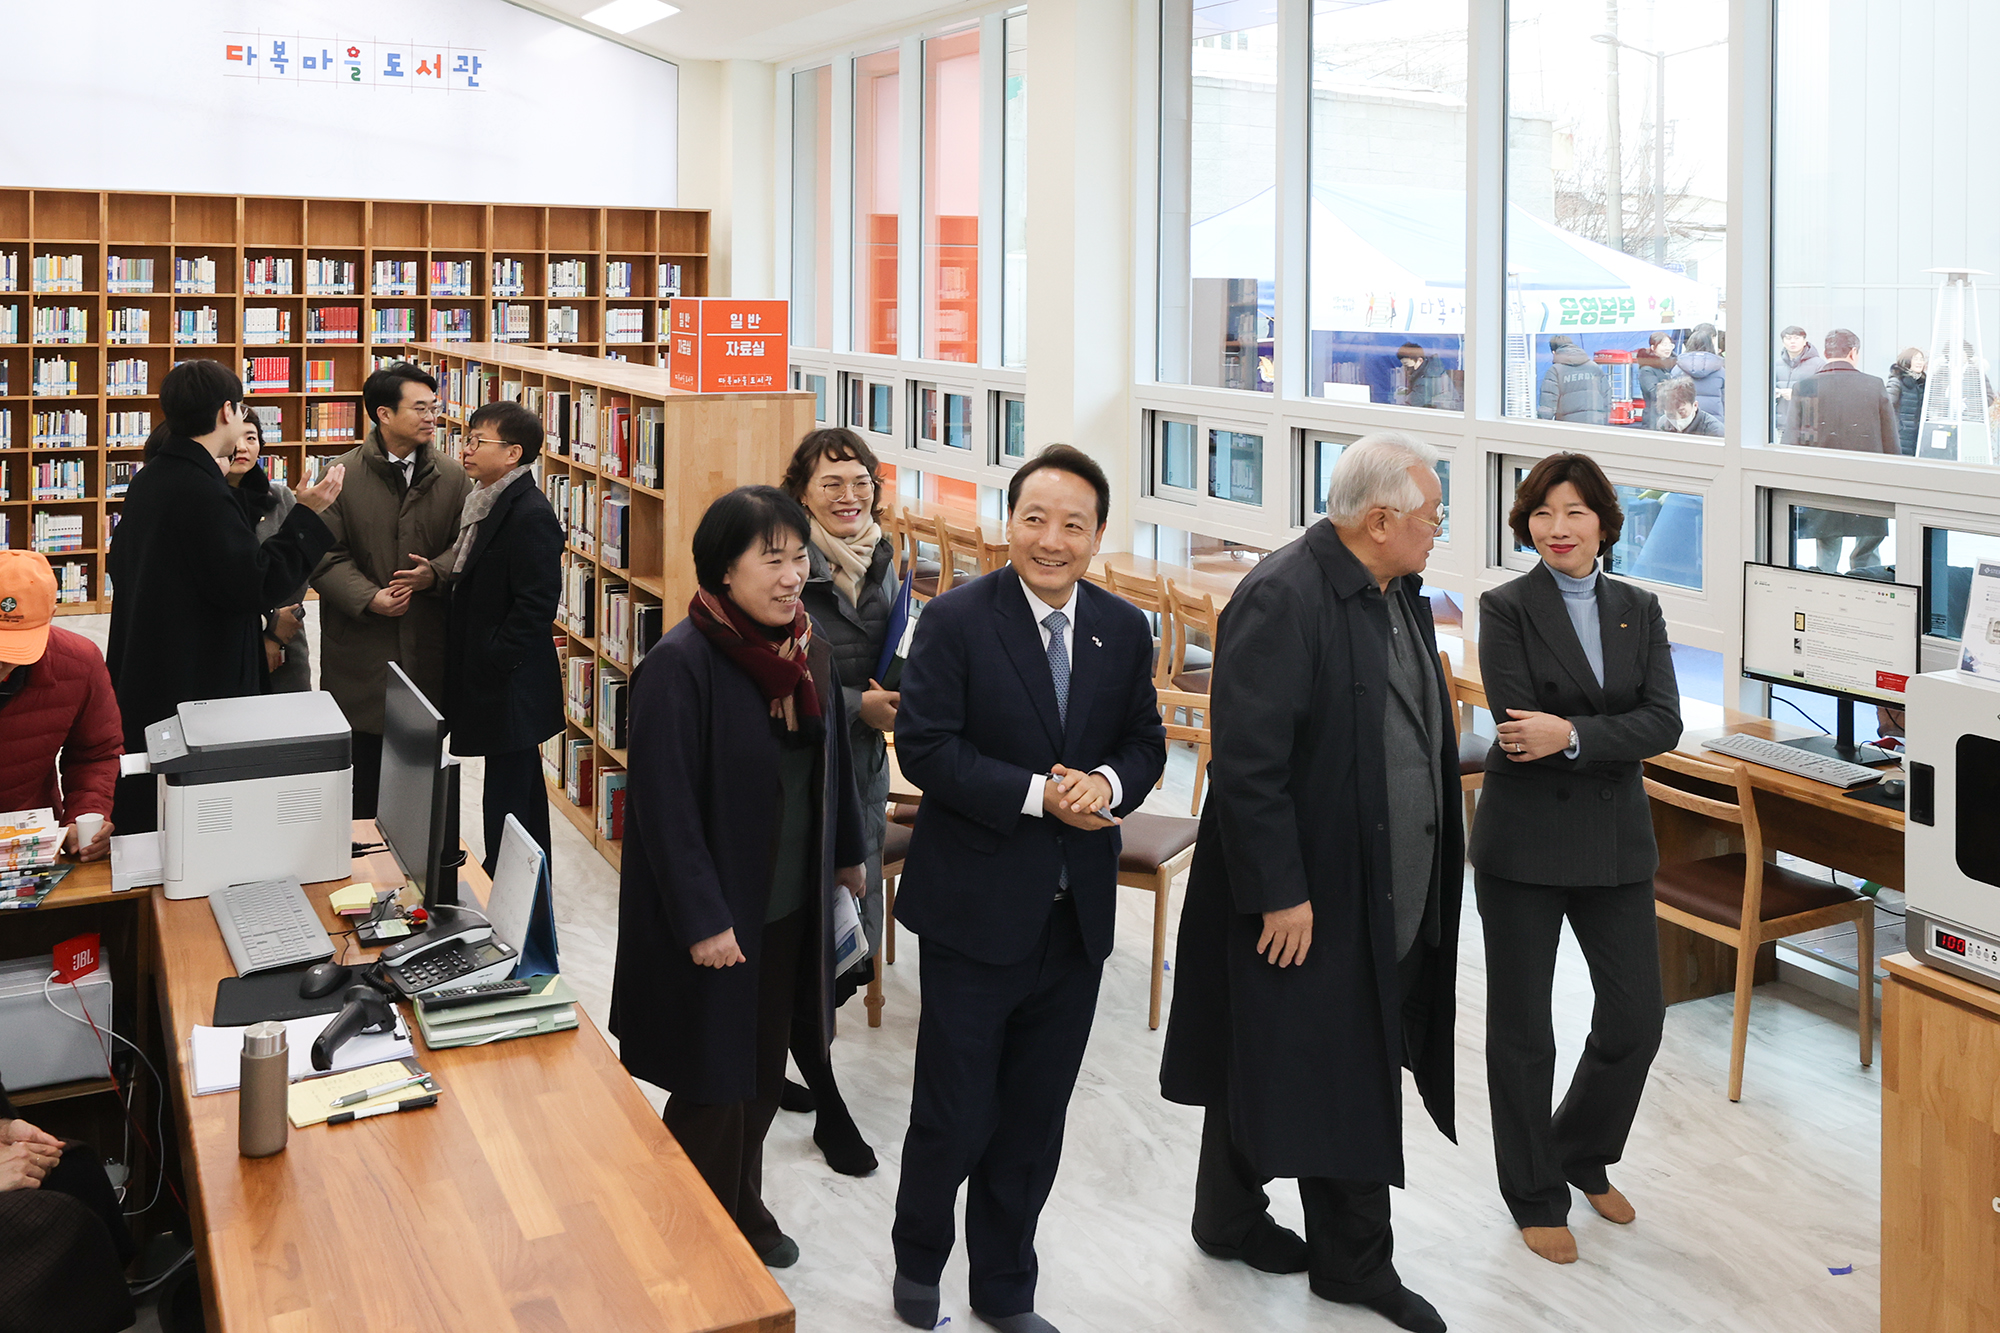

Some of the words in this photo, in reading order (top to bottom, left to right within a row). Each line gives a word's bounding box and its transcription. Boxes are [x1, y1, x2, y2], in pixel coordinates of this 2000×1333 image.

[1559, 296, 1635, 325] 운영본부
[730, 313, 761, 329] 일반
[725, 341, 765, 356] 자료실
[72, 948, 94, 971] JBL
